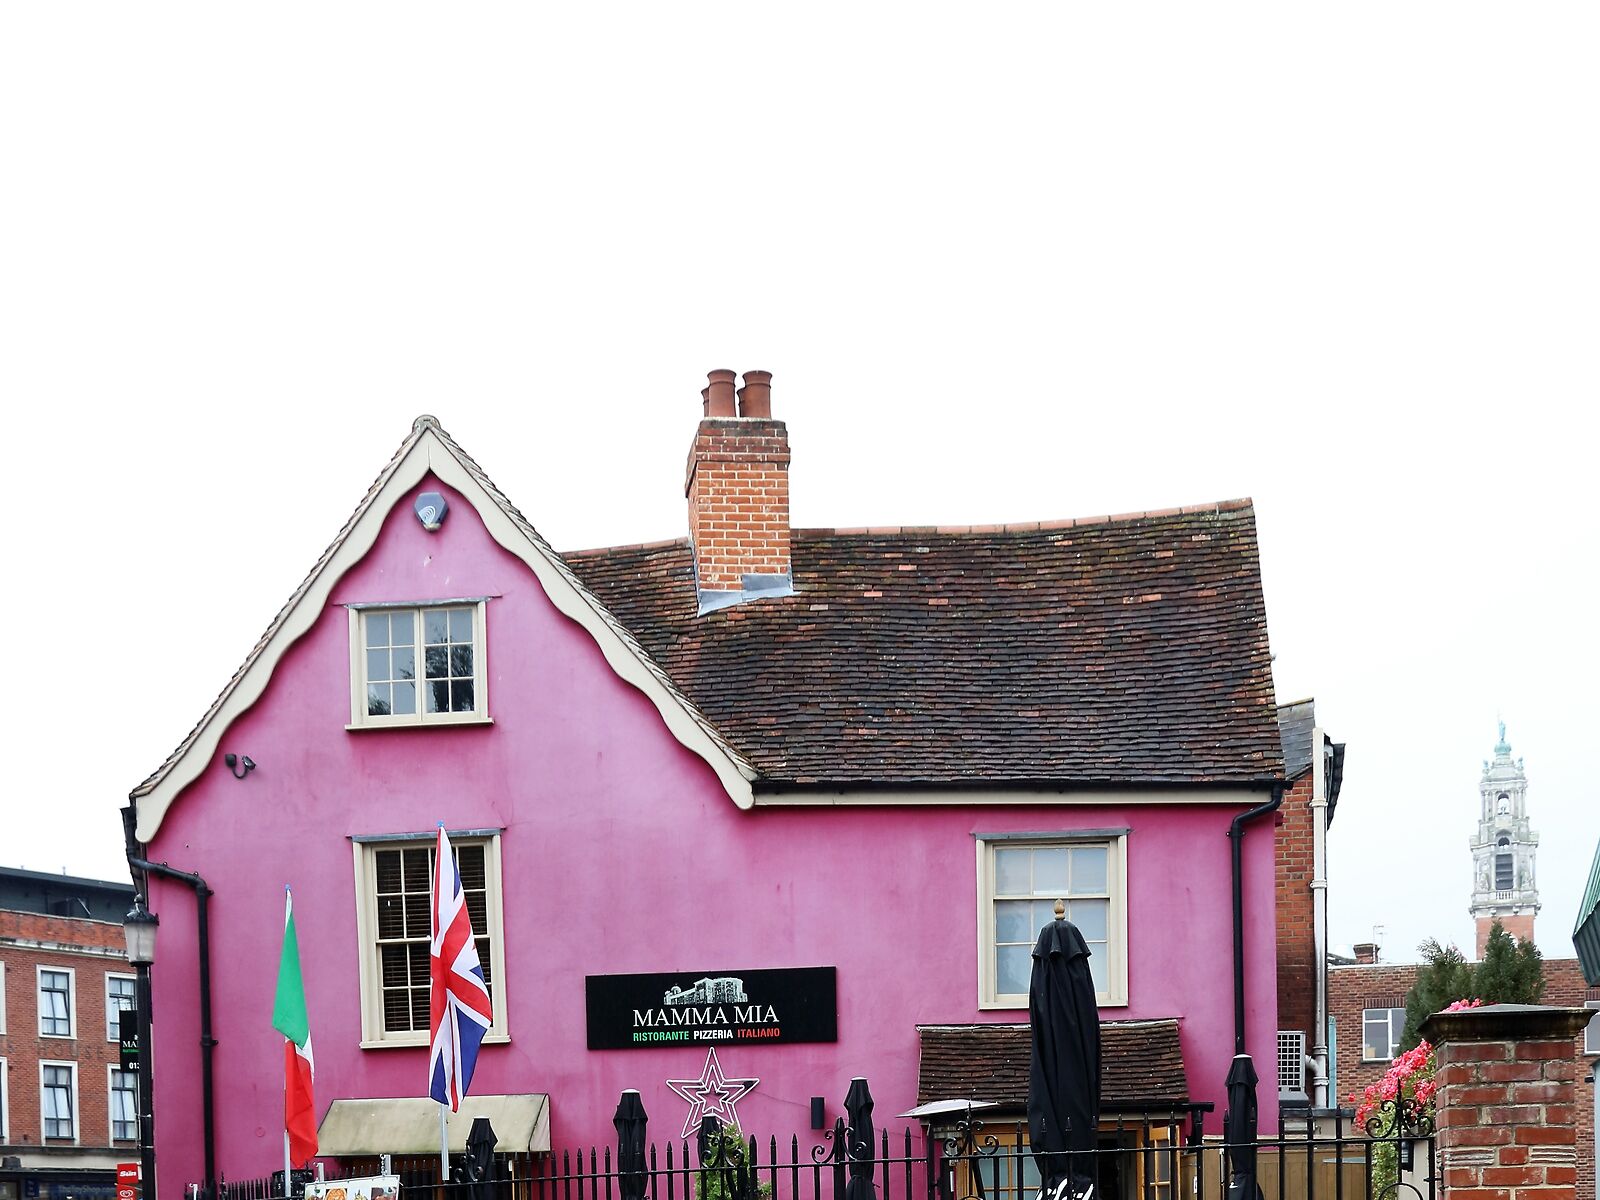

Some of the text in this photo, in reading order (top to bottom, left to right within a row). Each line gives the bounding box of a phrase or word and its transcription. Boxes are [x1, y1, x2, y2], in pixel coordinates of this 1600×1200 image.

[633, 1004, 780, 1027] MAMMA MIA
[633, 1028, 780, 1042] RISTORANTE PIZZERIA ITALIANO
